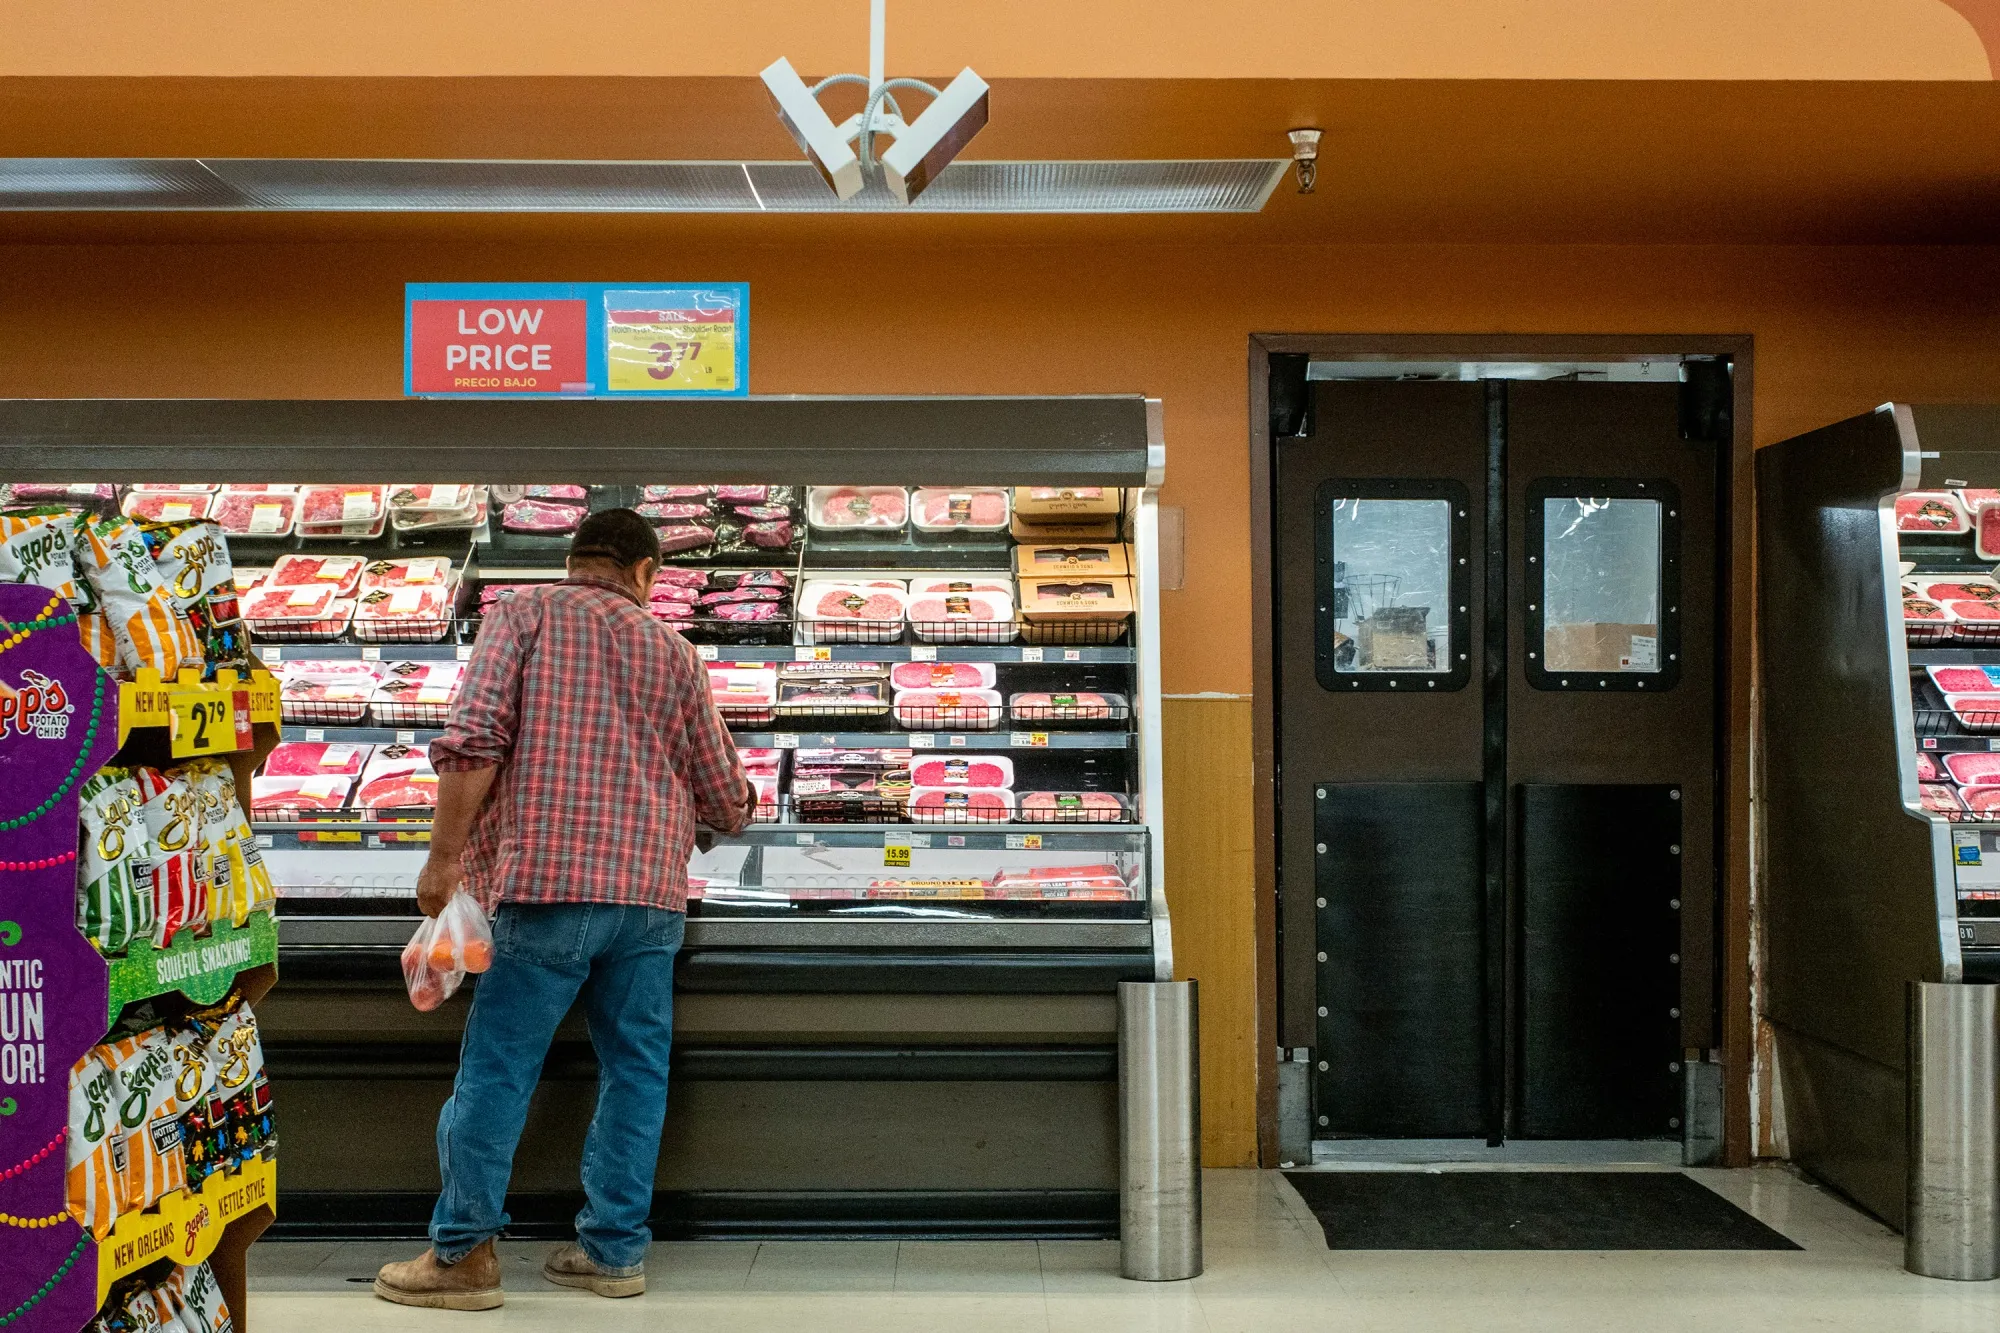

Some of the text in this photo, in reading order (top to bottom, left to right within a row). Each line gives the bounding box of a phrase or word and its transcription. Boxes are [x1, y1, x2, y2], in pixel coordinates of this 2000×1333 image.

[458, 308, 543, 335] LOW
[658, 312, 685, 322] SALE
[683, 325, 713, 333] Shoulder
[713, 325, 731, 333] Roast
[446, 344, 552, 371] PRICE
[454, 377, 537, 387] PRECIO BAJO
[136, 691, 154, 712] NEW
[256, 692, 274, 711] STYLE
[35, 715, 67, 727] POTATO
[37, 727, 65, 737] CHIPS
[886, 849, 909, 859] 15.99
[156, 937, 251, 984] SOULFUL SNACKING!
[153, 1121, 177, 1139] HOTTER
[217, 1177, 266, 1219] KETTLE STYLE
[114, 1221, 175, 1270] NEW ORLEANS
